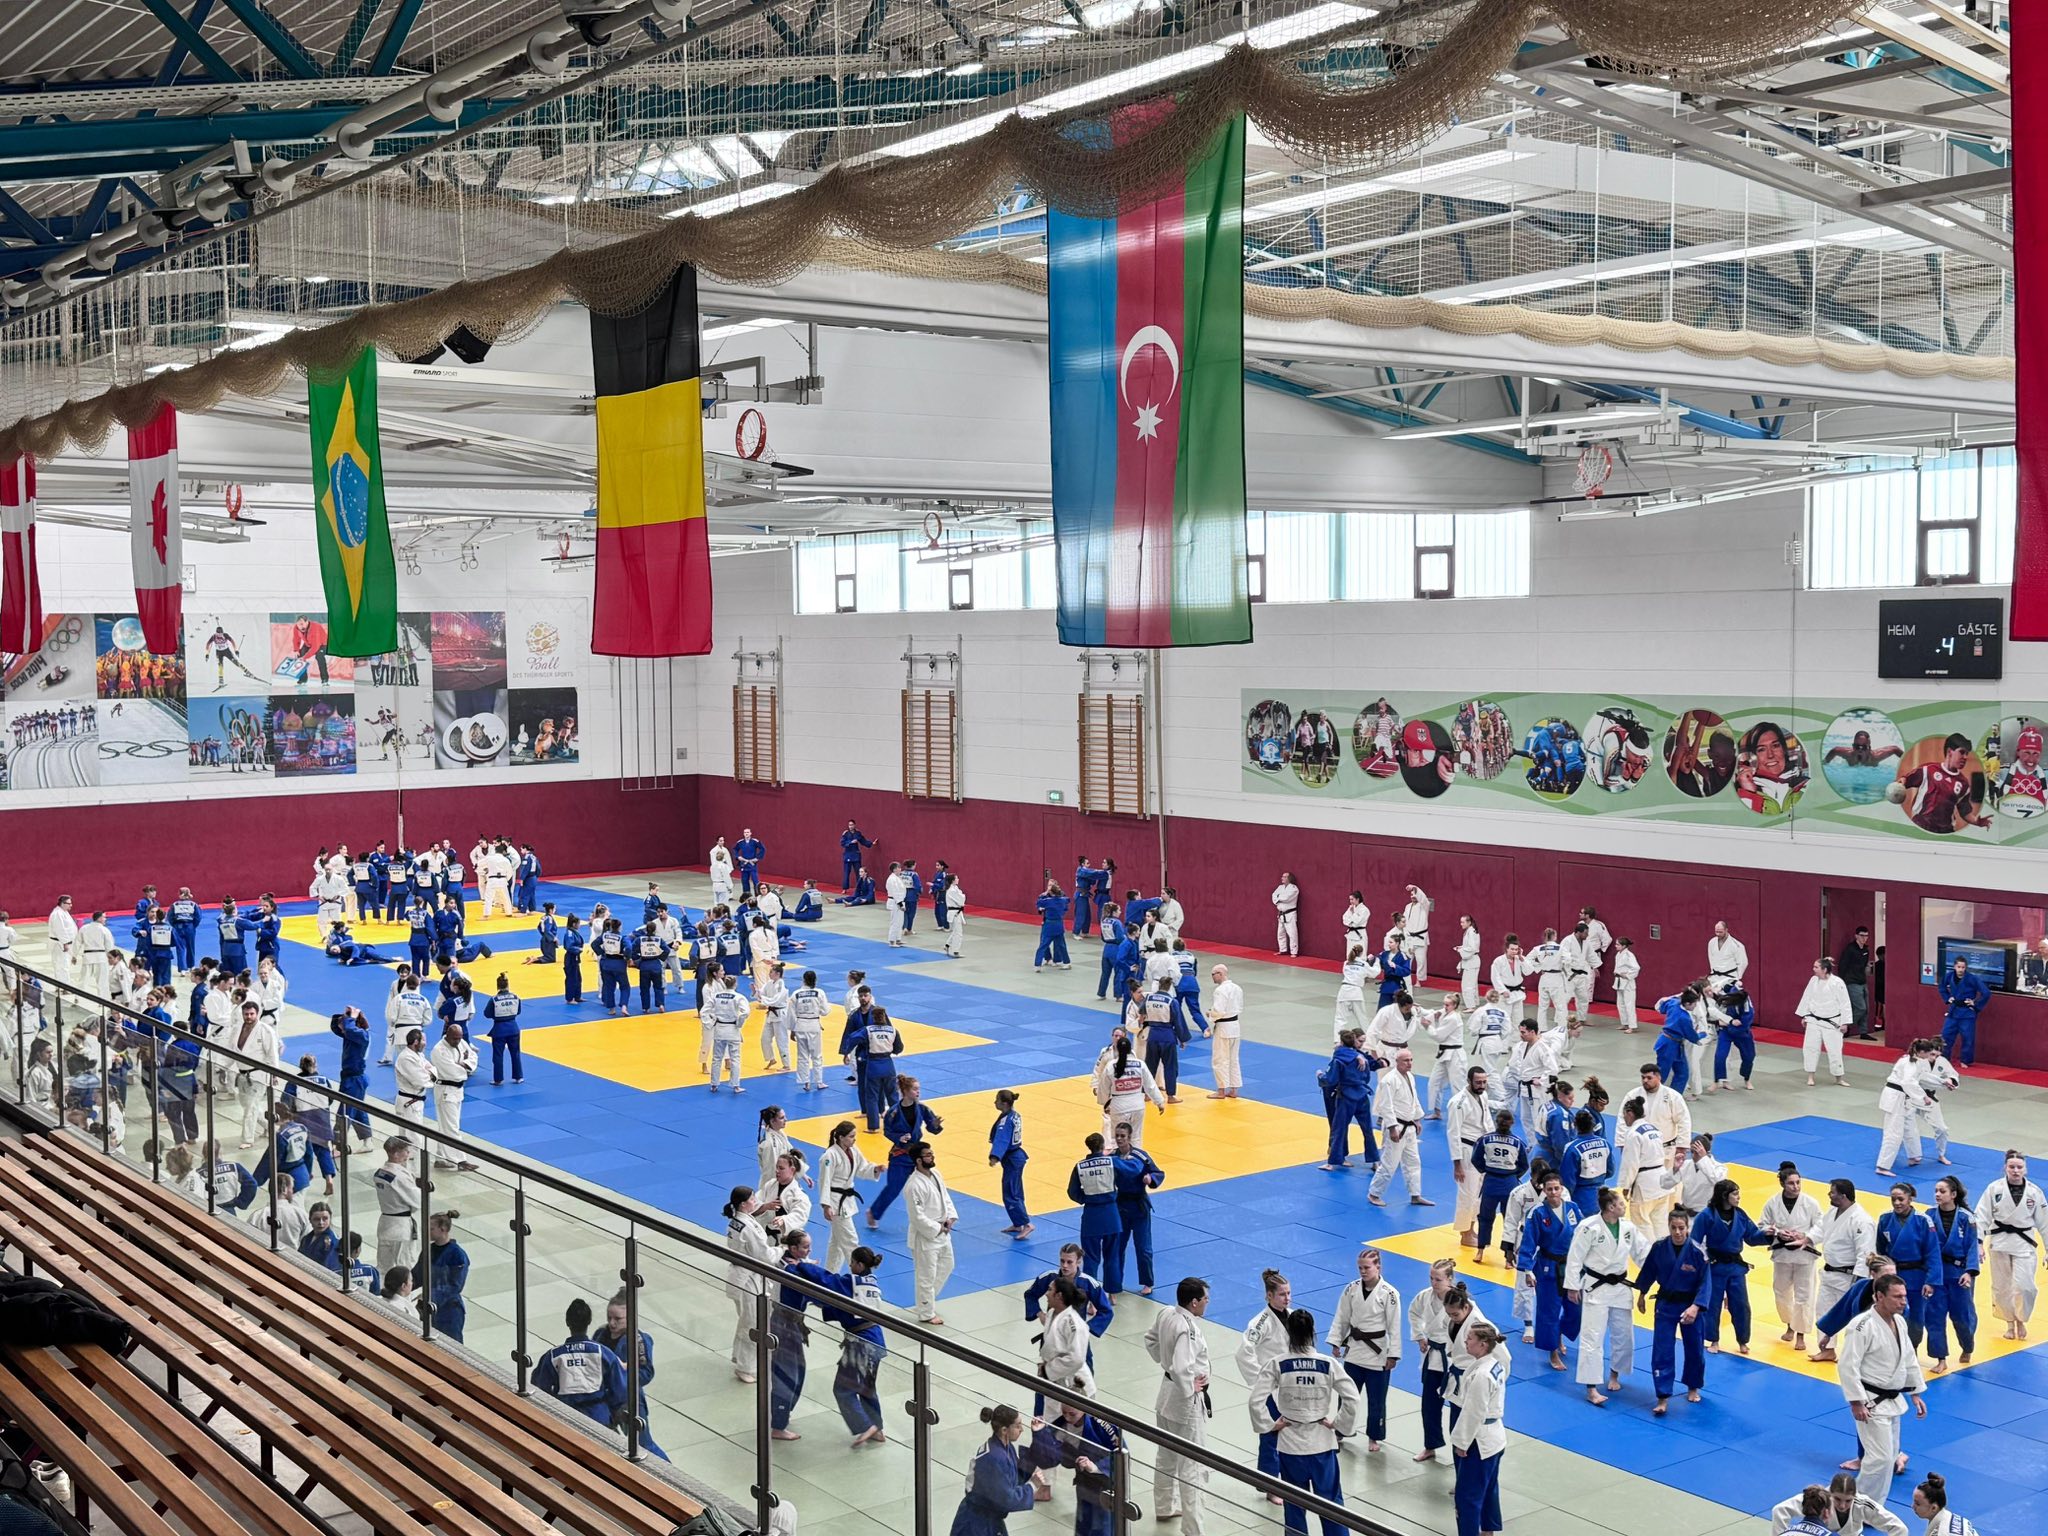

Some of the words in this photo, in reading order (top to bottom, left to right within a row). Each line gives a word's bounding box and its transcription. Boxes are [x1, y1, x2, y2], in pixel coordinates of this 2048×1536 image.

[1887, 624, 1916, 636] HEIM
[1957, 622, 1998, 636] GÄSTE
[25, 654, 48, 678] 2014
[526, 656, 560, 670] Ball
[1953, 781, 1963, 794] 6
[567, 1358, 587, 1367] BEL
[1296, 1376, 1315, 1385] FIN
